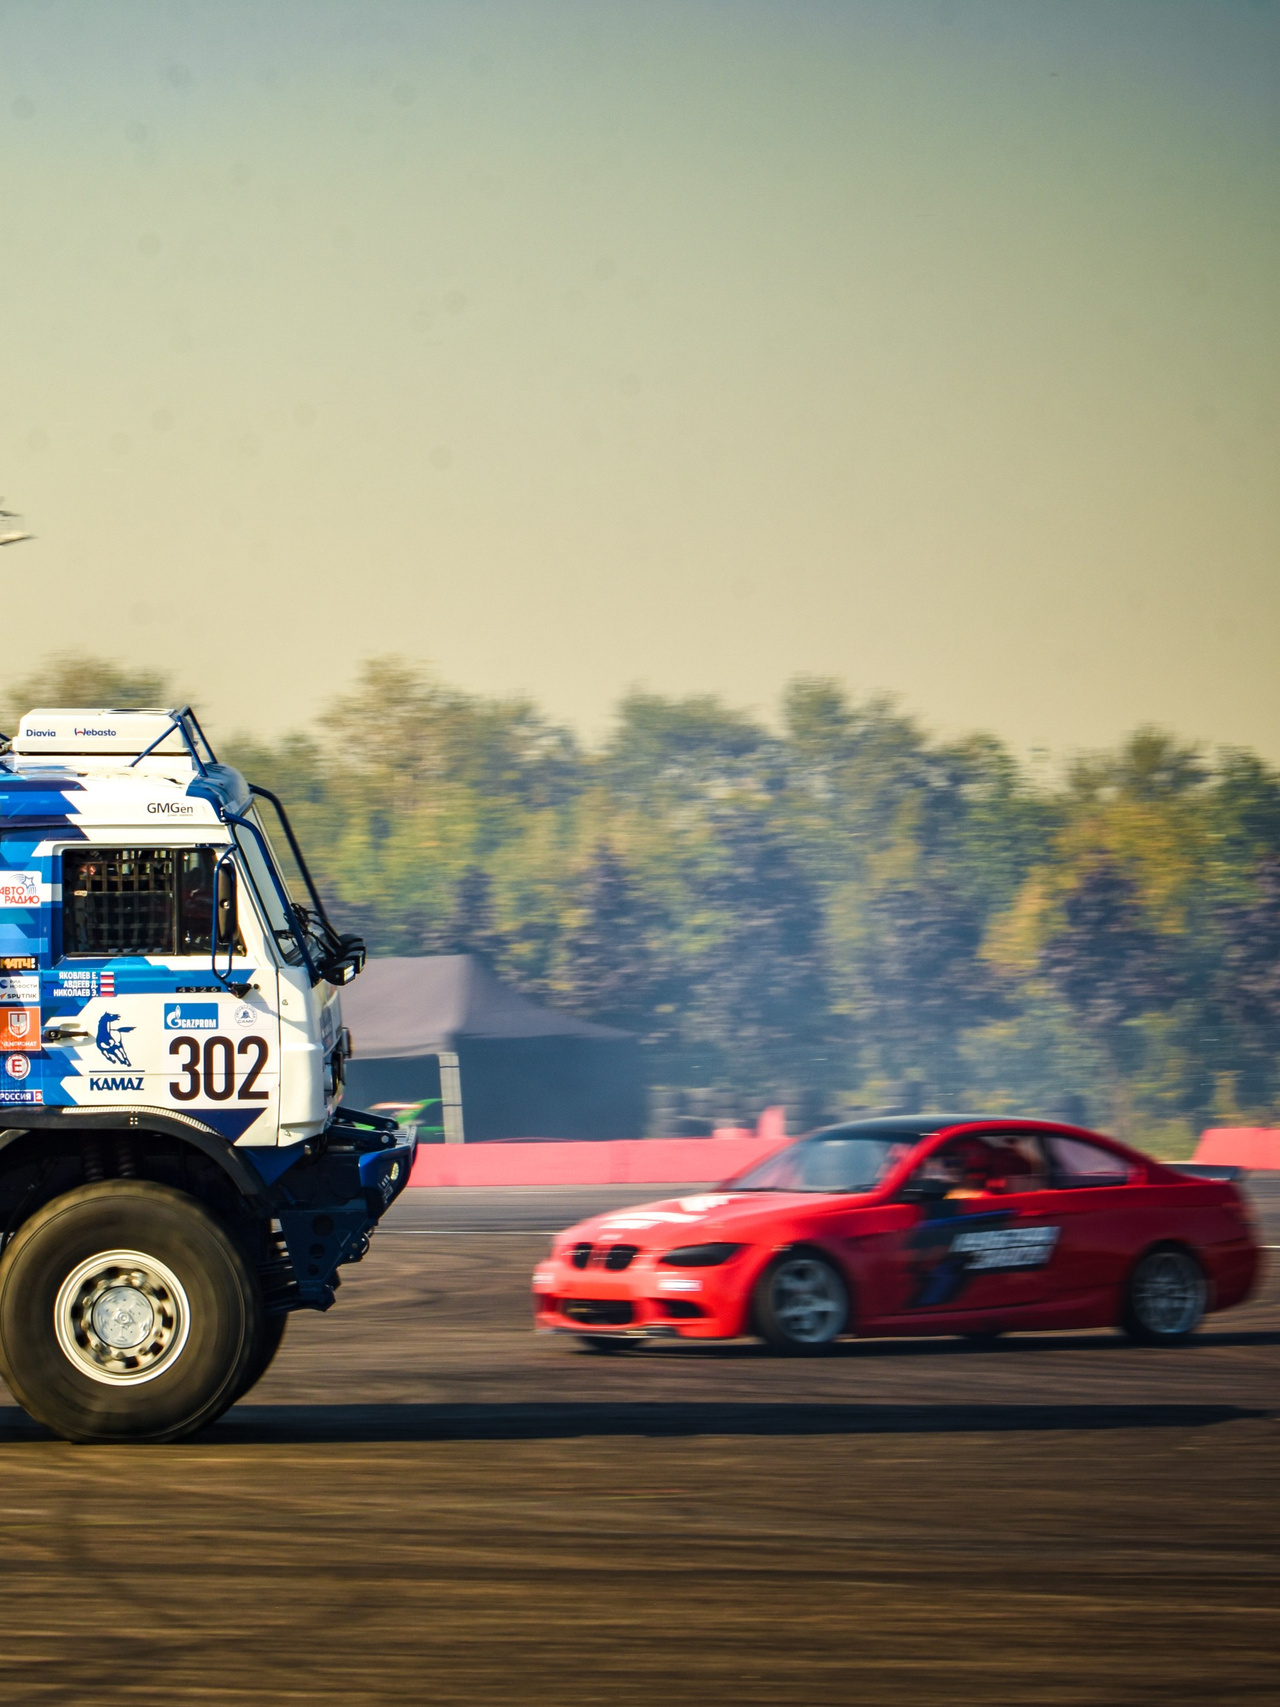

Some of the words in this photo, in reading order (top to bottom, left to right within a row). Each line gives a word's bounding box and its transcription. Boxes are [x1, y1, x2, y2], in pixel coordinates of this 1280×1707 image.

[26, 729, 56, 737] Diavia
[74, 728, 116, 737] Webasto
[147, 802, 194, 814] GMGen
[4, 895, 40, 904] РАДИО
[58, 971, 90, 979] ЯКОВЛЕВ
[53, 989, 90, 997] НИКОЛАЕВ
[181, 1019, 217, 1028] GAZPROM
[169, 1035, 269, 1101] 302
[89, 1077, 145, 1091] KAMAZ
[0, 1092, 32, 1100] РОССИЯ
